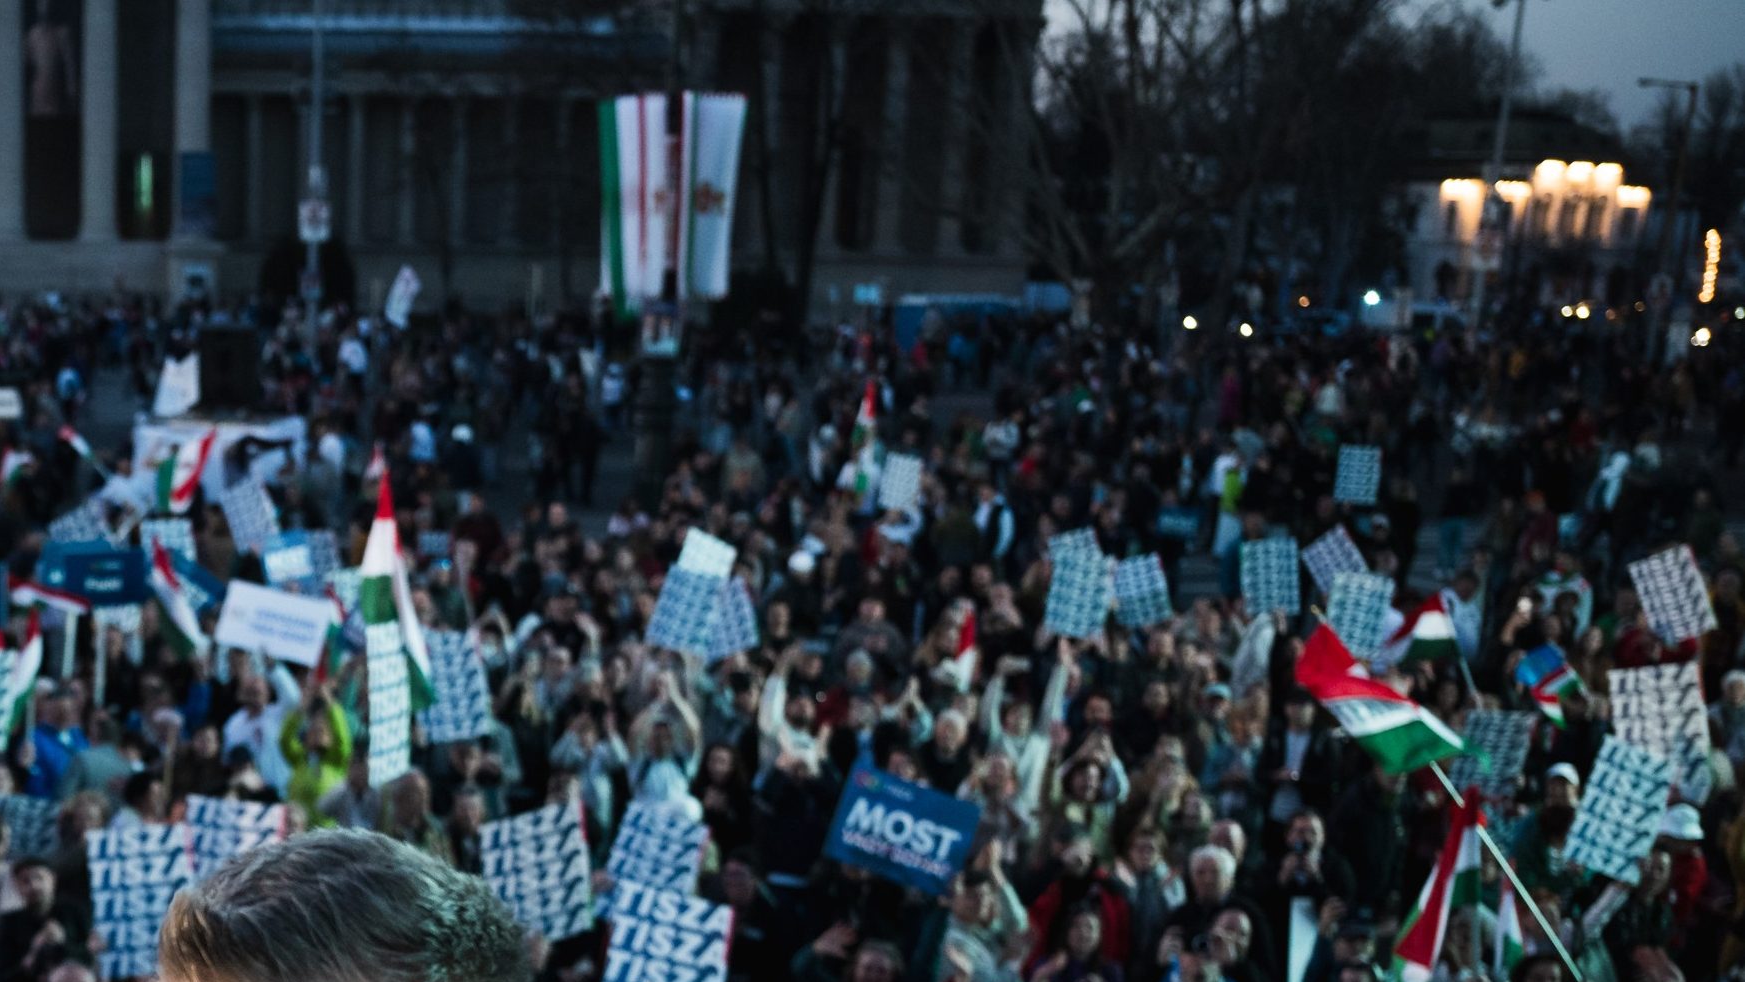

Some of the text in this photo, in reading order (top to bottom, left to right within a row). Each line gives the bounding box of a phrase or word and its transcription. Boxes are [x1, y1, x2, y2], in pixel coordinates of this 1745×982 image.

[845, 796, 962, 861] MOST
[92, 886, 171, 920] TISZ
[615, 879, 733, 935] TISZA
[608, 916, 726, 968] TISZA
